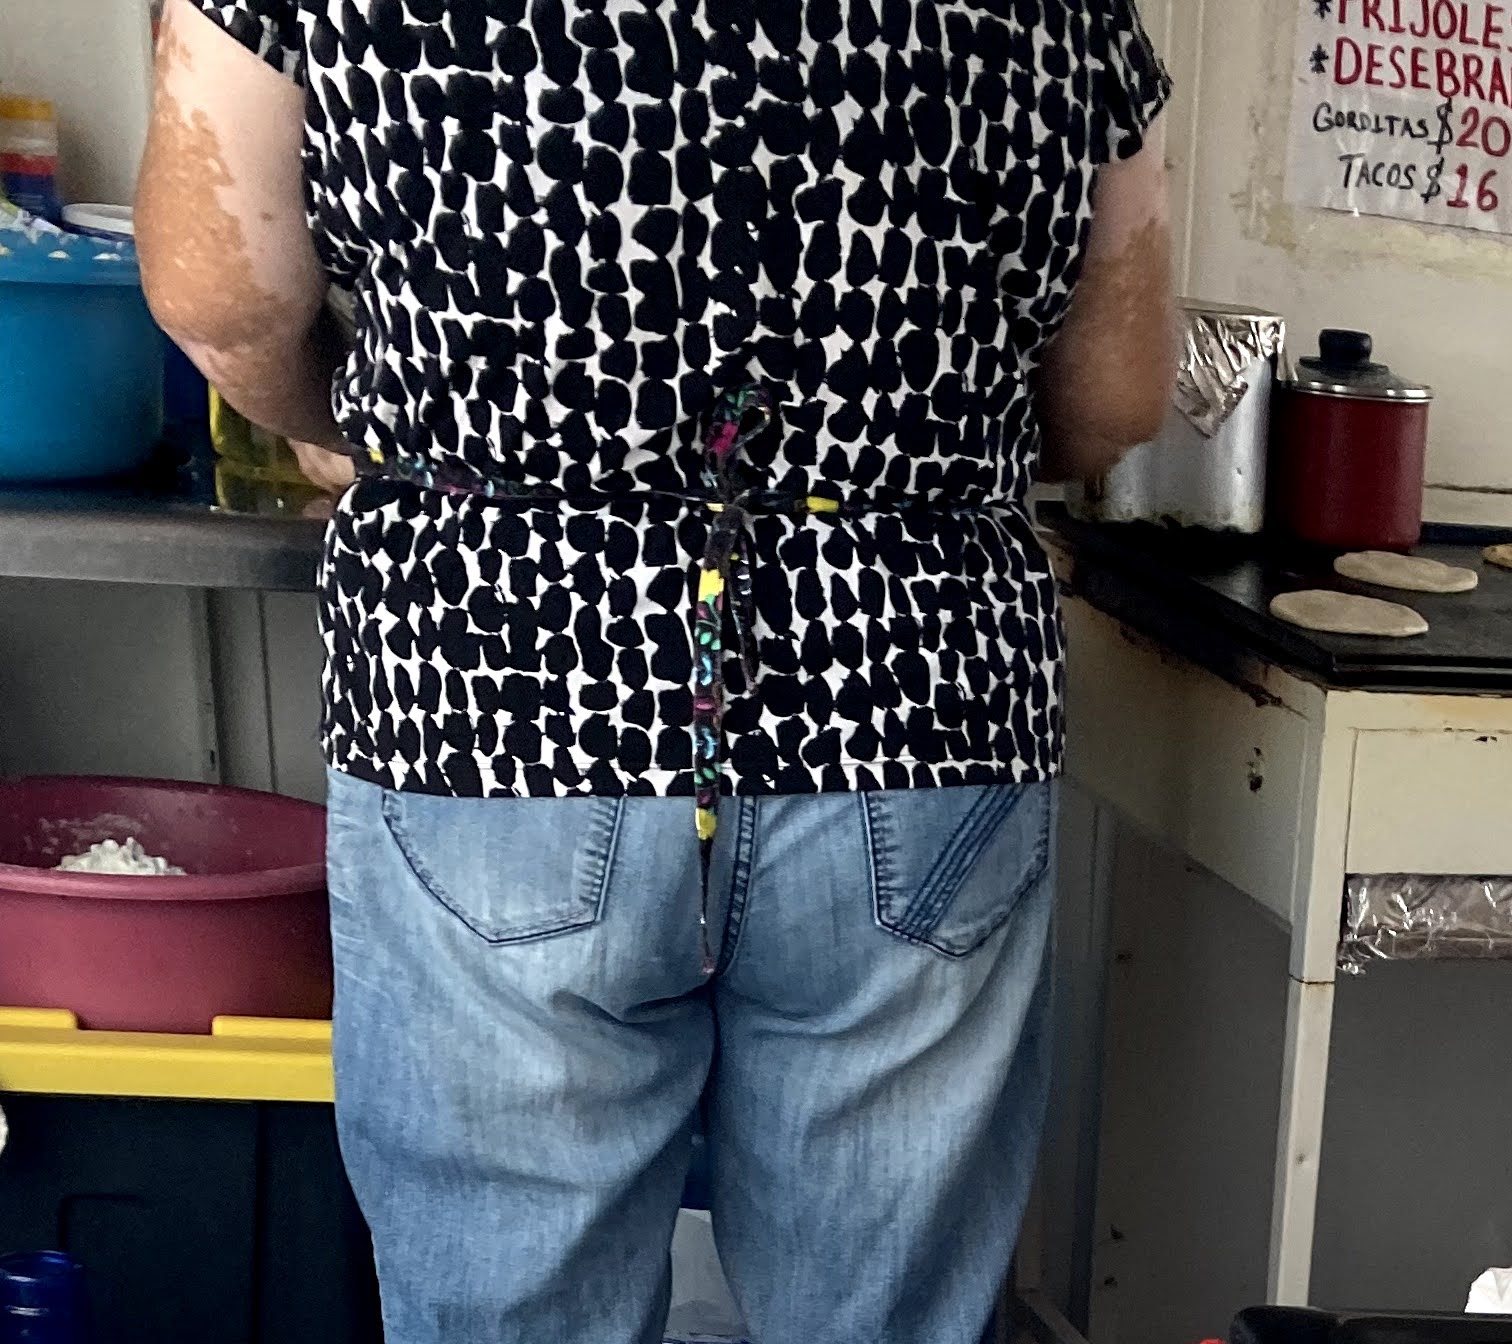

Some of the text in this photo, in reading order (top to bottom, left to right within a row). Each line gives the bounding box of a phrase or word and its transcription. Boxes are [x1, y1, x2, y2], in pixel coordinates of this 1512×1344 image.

[1427, 97, 1511, 157] $20
[1338, 152, 1498, 211] TACOS $16
